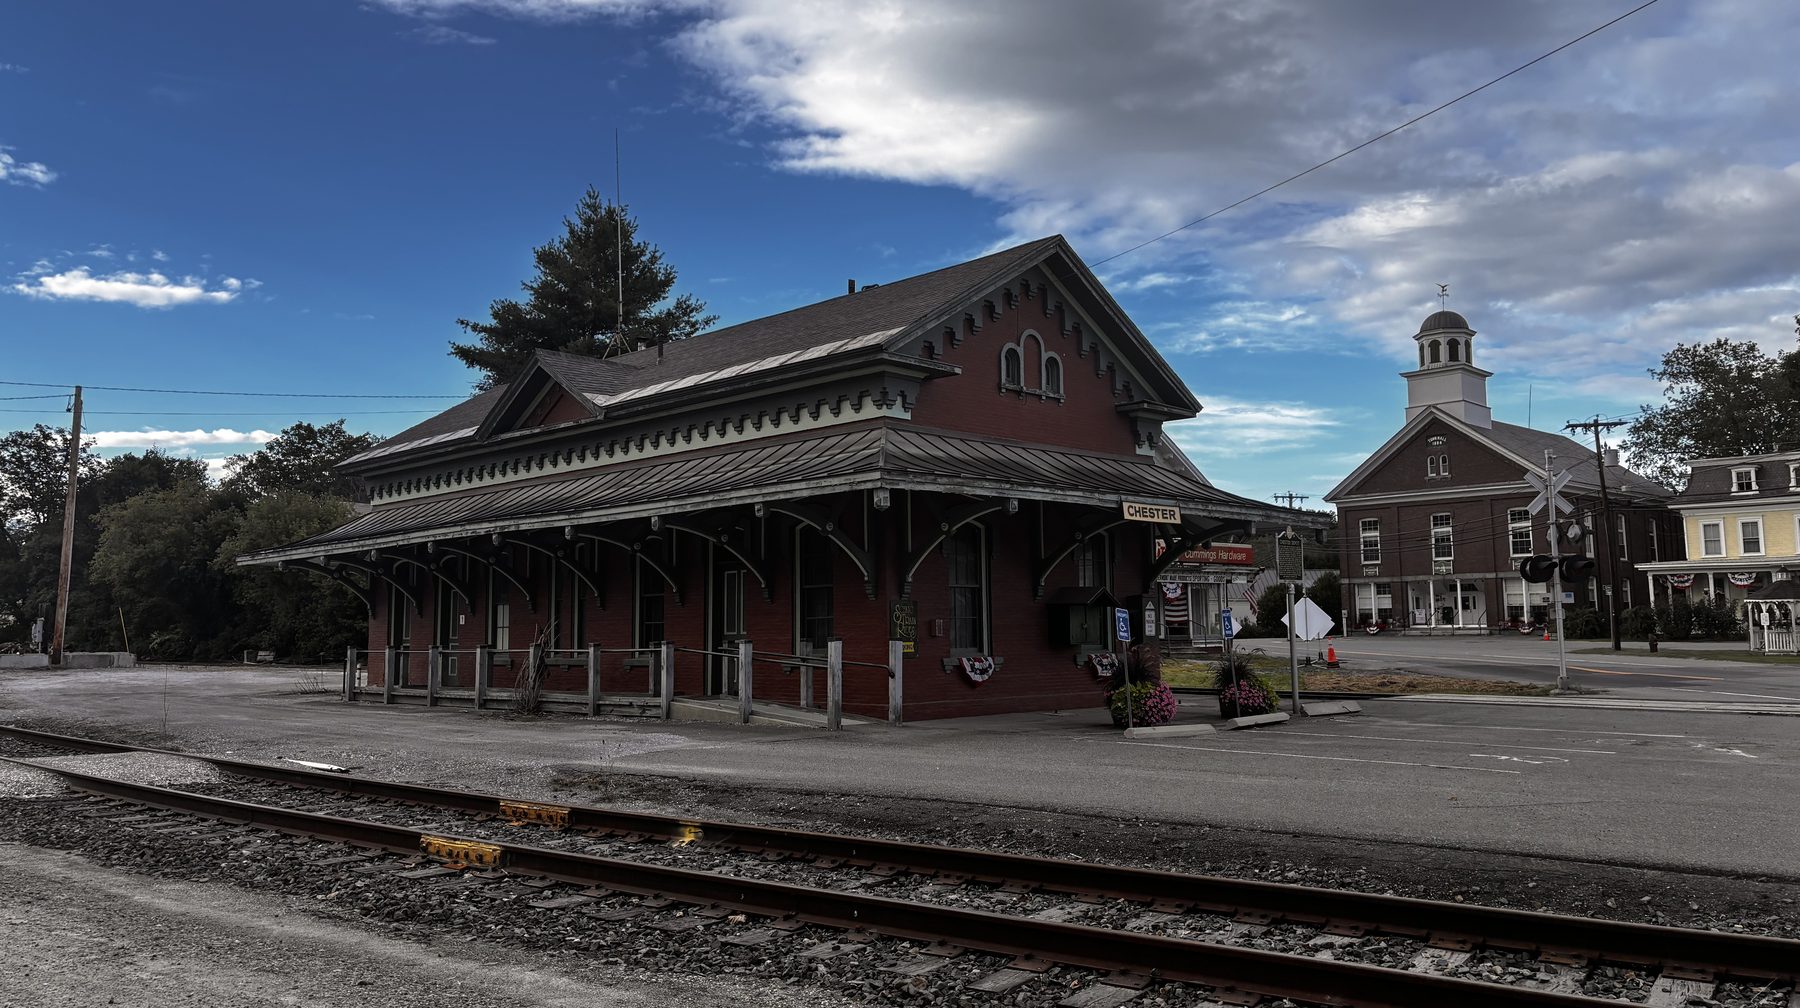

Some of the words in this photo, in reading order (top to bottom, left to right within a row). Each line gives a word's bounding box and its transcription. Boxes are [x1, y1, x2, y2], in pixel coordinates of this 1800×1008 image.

[1127, 505, 1176, 520] CHESTER
[1184, 550, 1217, 562] Cummings
[1218, 550, 1247, 561] Hardware
